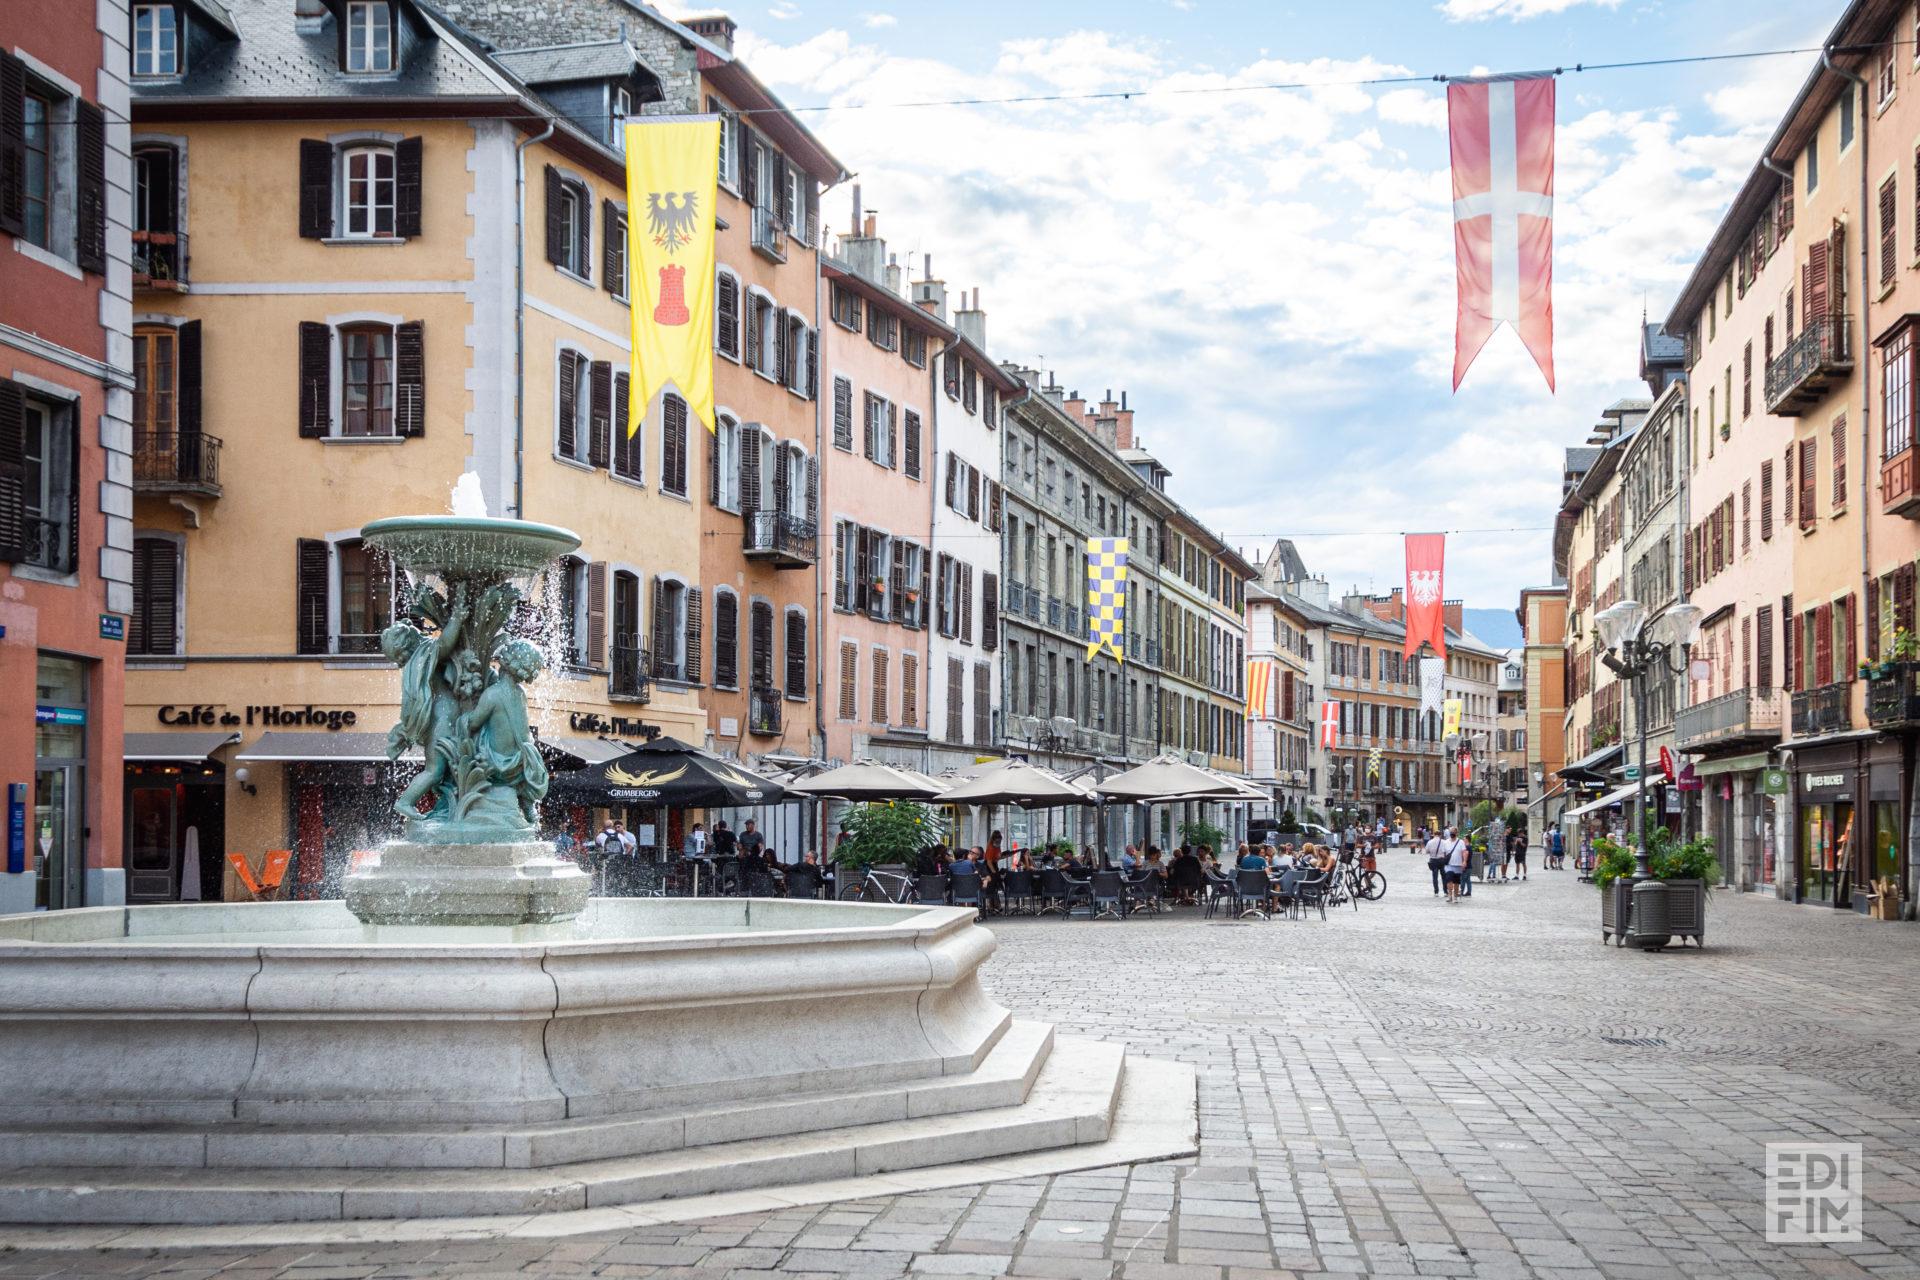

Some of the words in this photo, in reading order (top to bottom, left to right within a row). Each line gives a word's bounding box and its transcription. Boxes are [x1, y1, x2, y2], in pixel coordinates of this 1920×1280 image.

[158, 705, 215, 725] Café
[220, 712, 241, 725] de
[246, 705, 357, 731] l'Horloge
[570, 712, 599, 733] Café
[610, 789, 658, 797] GRIMBERGEN
